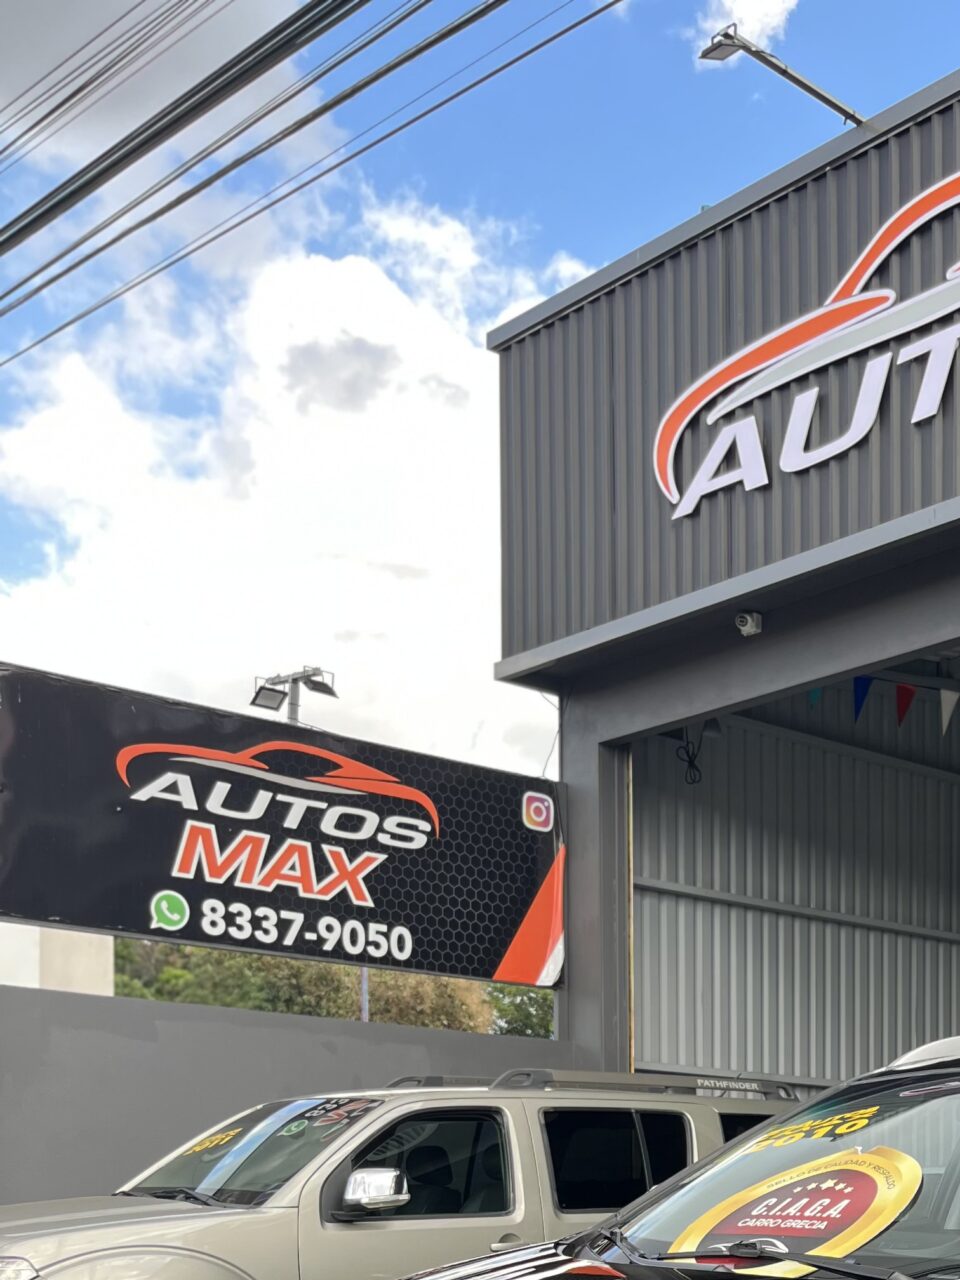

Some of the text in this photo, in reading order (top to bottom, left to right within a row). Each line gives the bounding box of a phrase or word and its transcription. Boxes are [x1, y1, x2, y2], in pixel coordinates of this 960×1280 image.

[130, 771, 432, 850] AUTOS
[171, 819, 388, 908] MAX
[201, 898, 413, 961] 8337-9050
[696, 1078, 759, 1091] PATHFINDER
[737, 1218, 828, 1230] CARRO GRECIA
[751, 1198, 851, 1218] C.I.A.G.A.
